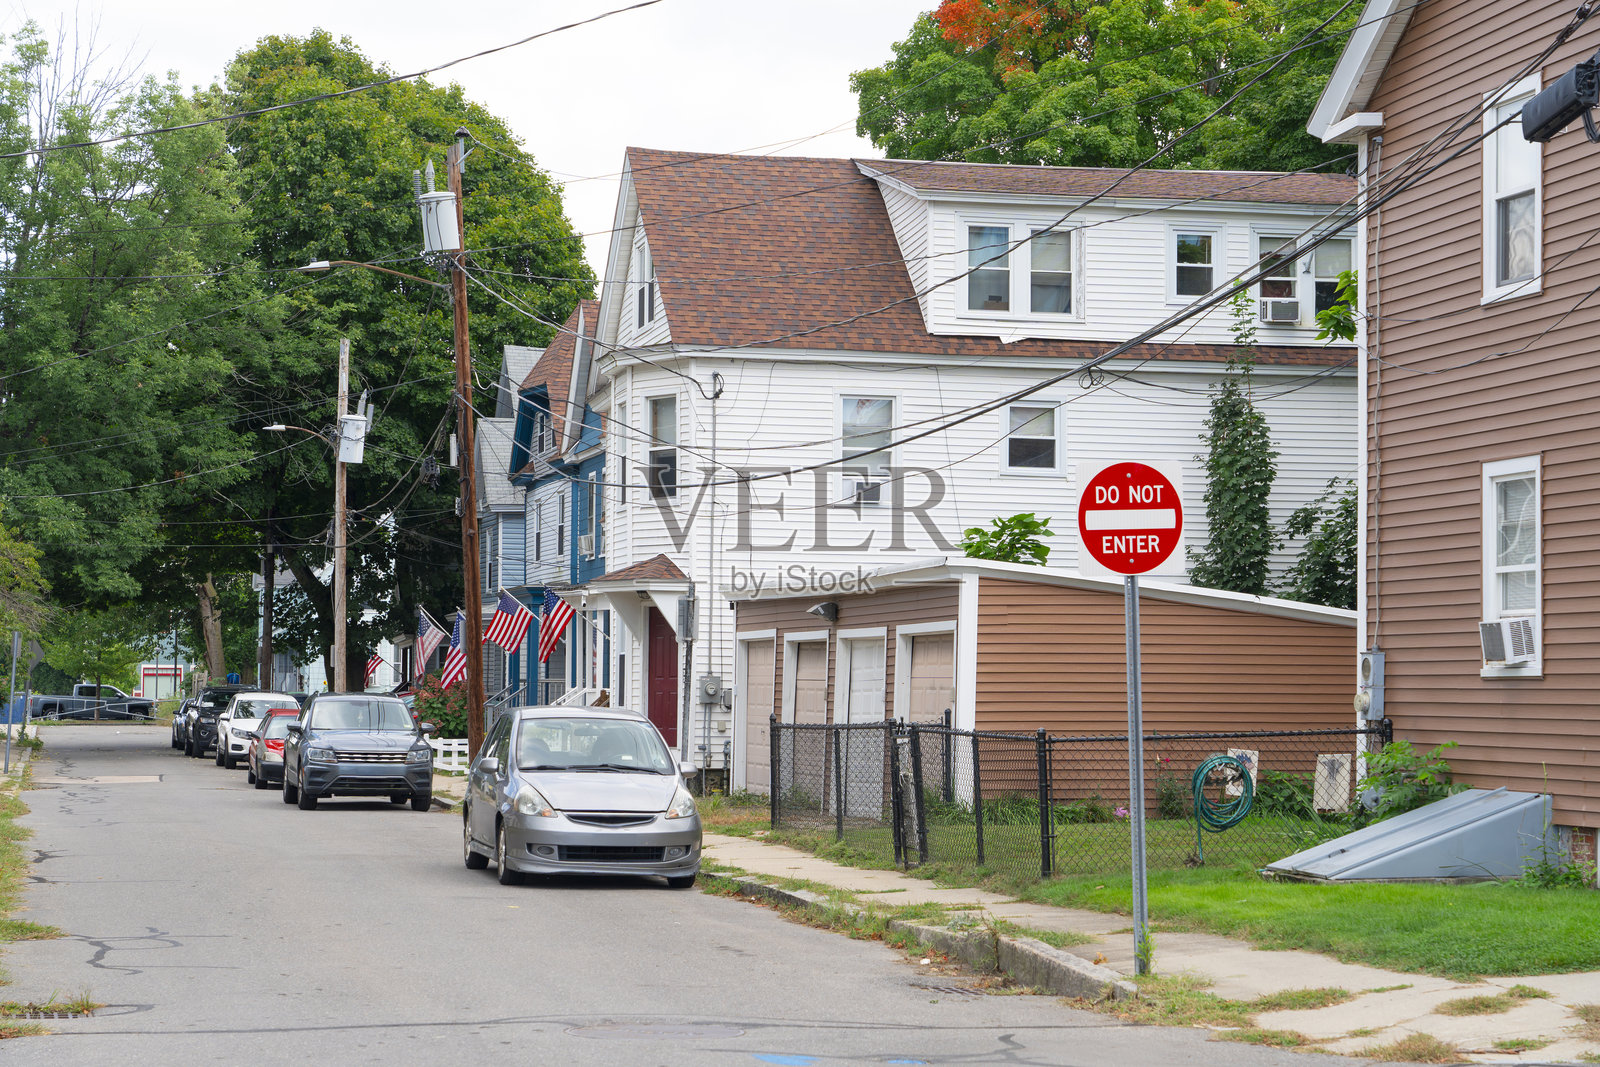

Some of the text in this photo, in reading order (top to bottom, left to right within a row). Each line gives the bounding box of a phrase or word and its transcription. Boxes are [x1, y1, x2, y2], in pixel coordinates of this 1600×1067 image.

[1095, 485, 1163, 504] DO NOT
[1102, 535, 1160, 554] ENTER
